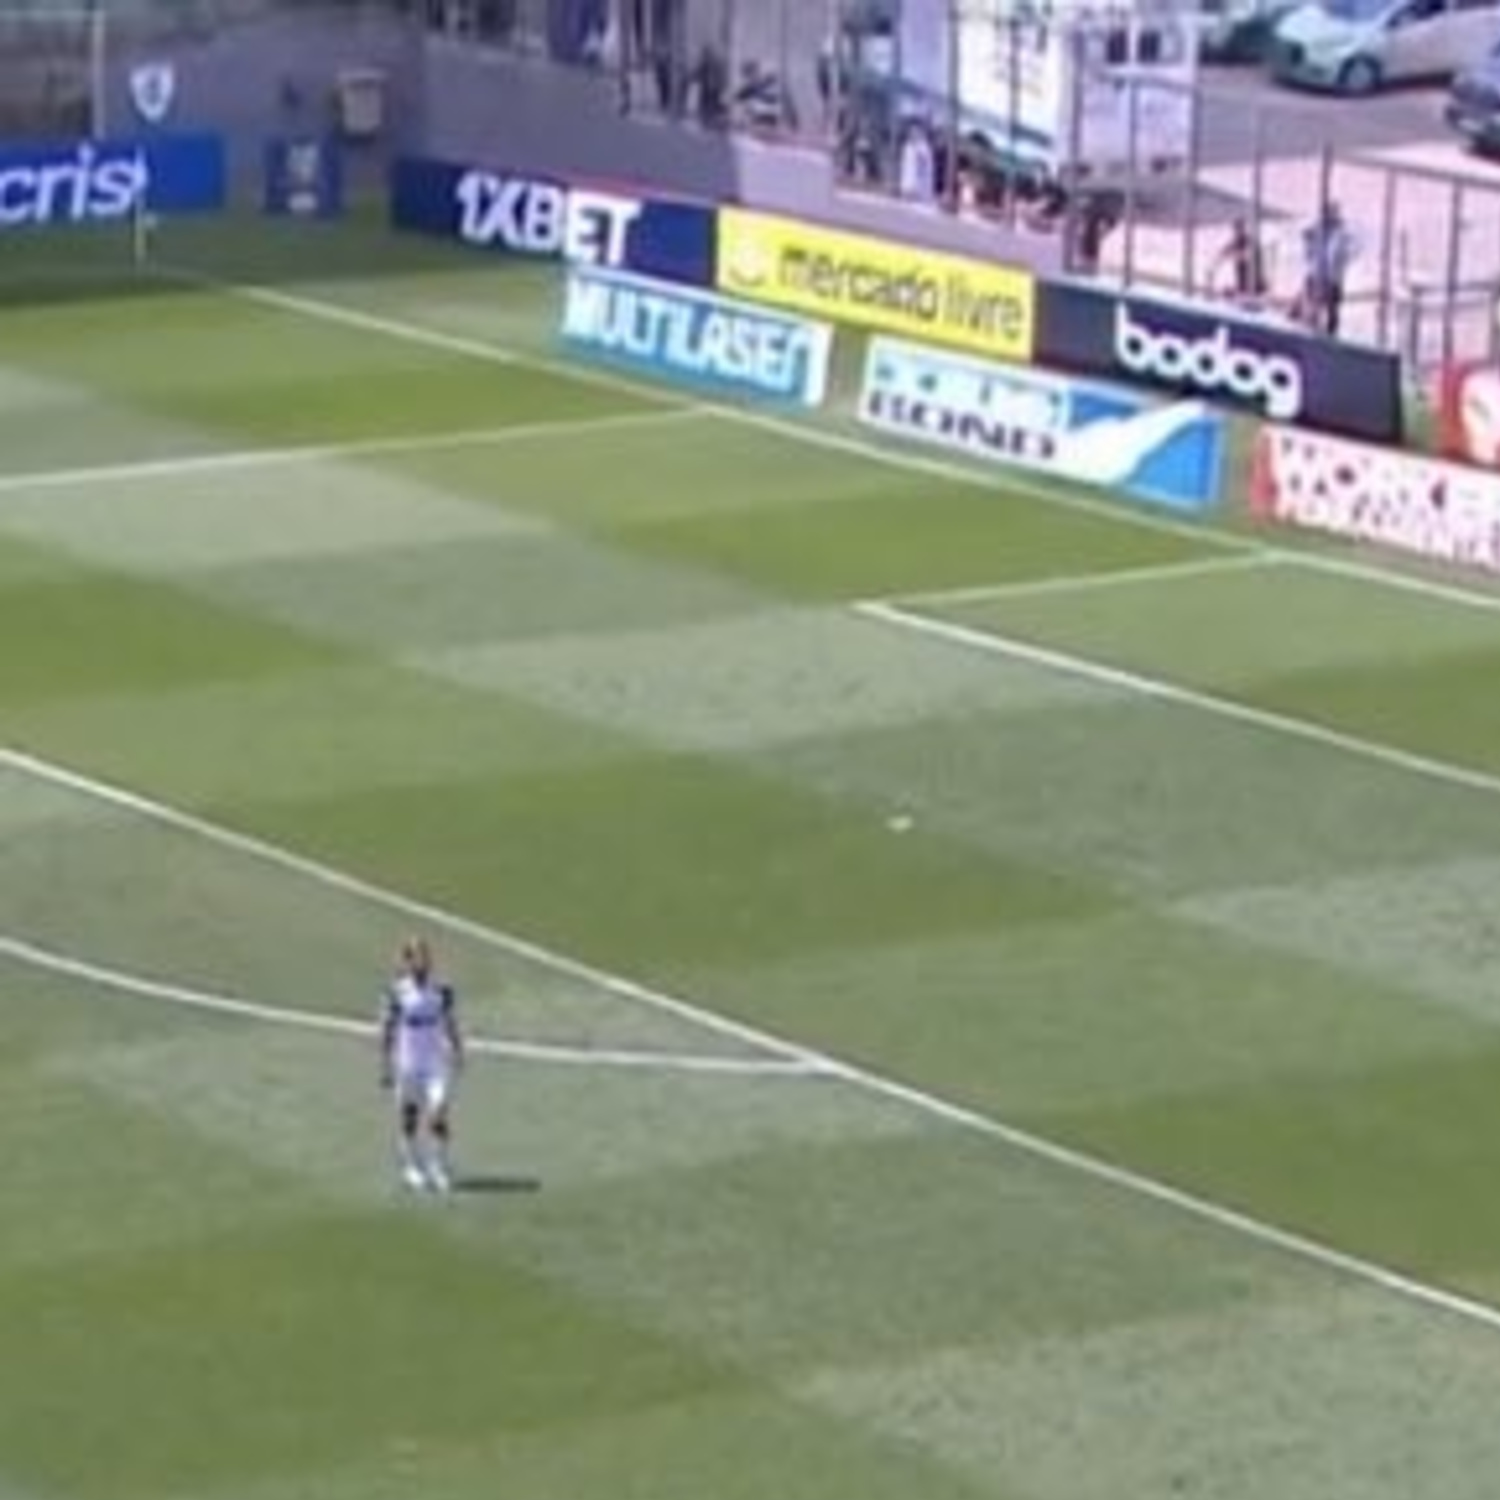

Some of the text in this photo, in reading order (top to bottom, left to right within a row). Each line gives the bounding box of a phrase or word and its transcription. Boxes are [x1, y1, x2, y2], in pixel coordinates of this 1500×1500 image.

[456, 169, 642, 266] 1XBET
[777, 243, 1024, 342] mercado livre
[1114, 302, 1300, 419] bodog
